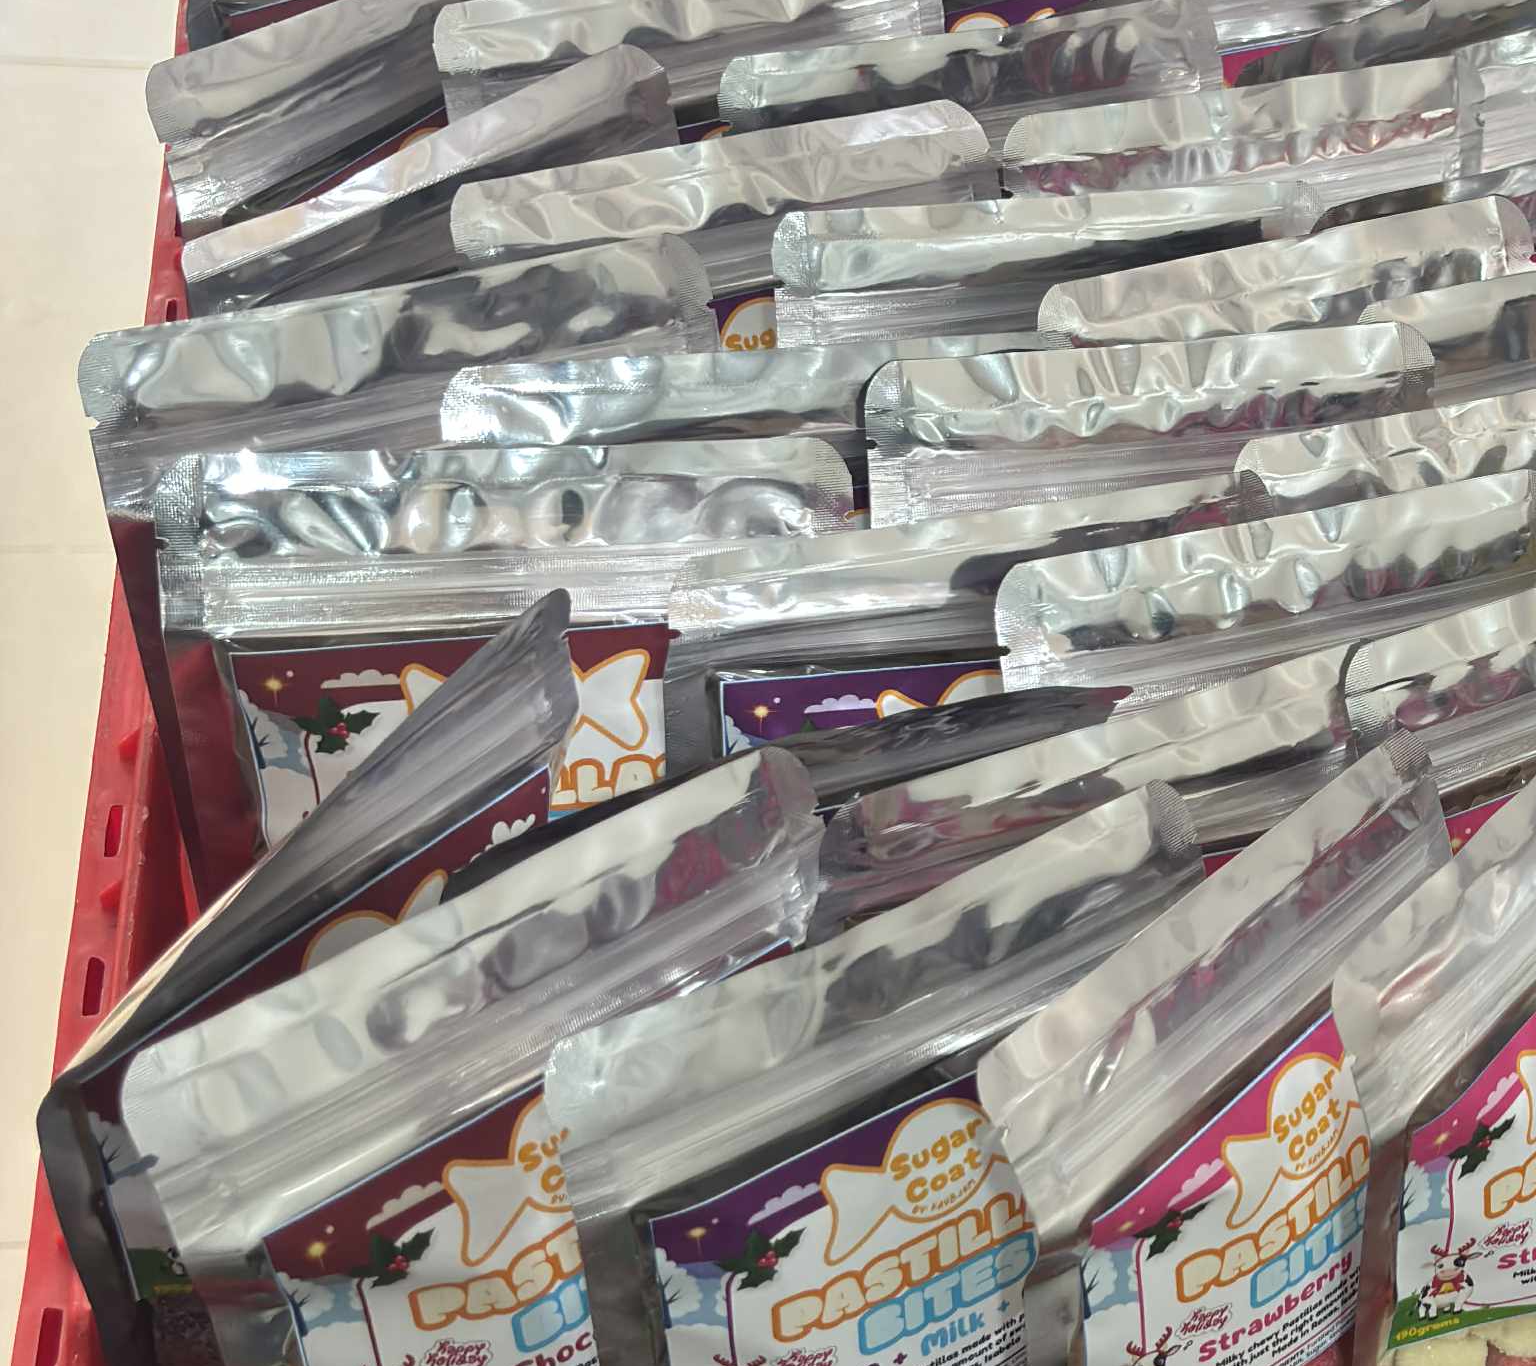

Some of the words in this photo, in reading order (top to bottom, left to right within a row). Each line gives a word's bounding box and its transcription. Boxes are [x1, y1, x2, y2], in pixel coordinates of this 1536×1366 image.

[1272, 1068, 1335, 1144] Sugar
[1288, 1098, 1341, 1161] Coat
[889, 1118, 983, 1181] Sugar
[905, 1147, 982, 1203] Coat
[857, 1231, 1035, 1355] BITES
[1198, 1252, 1353, 1362] Strawberry
[920, 1312, 986, 1357] Milk
[961, 1334, 991, 1355] made
[994, 1318, 1017, 1336] with
[1248, 1330, 1280, 1353] chewy
[1282, 1299, 1322, 1331] Pastillas
[1248, 1345, 1269, 1364] just
[1271, 1333, 1289, 1349] the
[1290, 1315, 1314, 1337] right
[1271, 1338, 1298, 1358] Made
